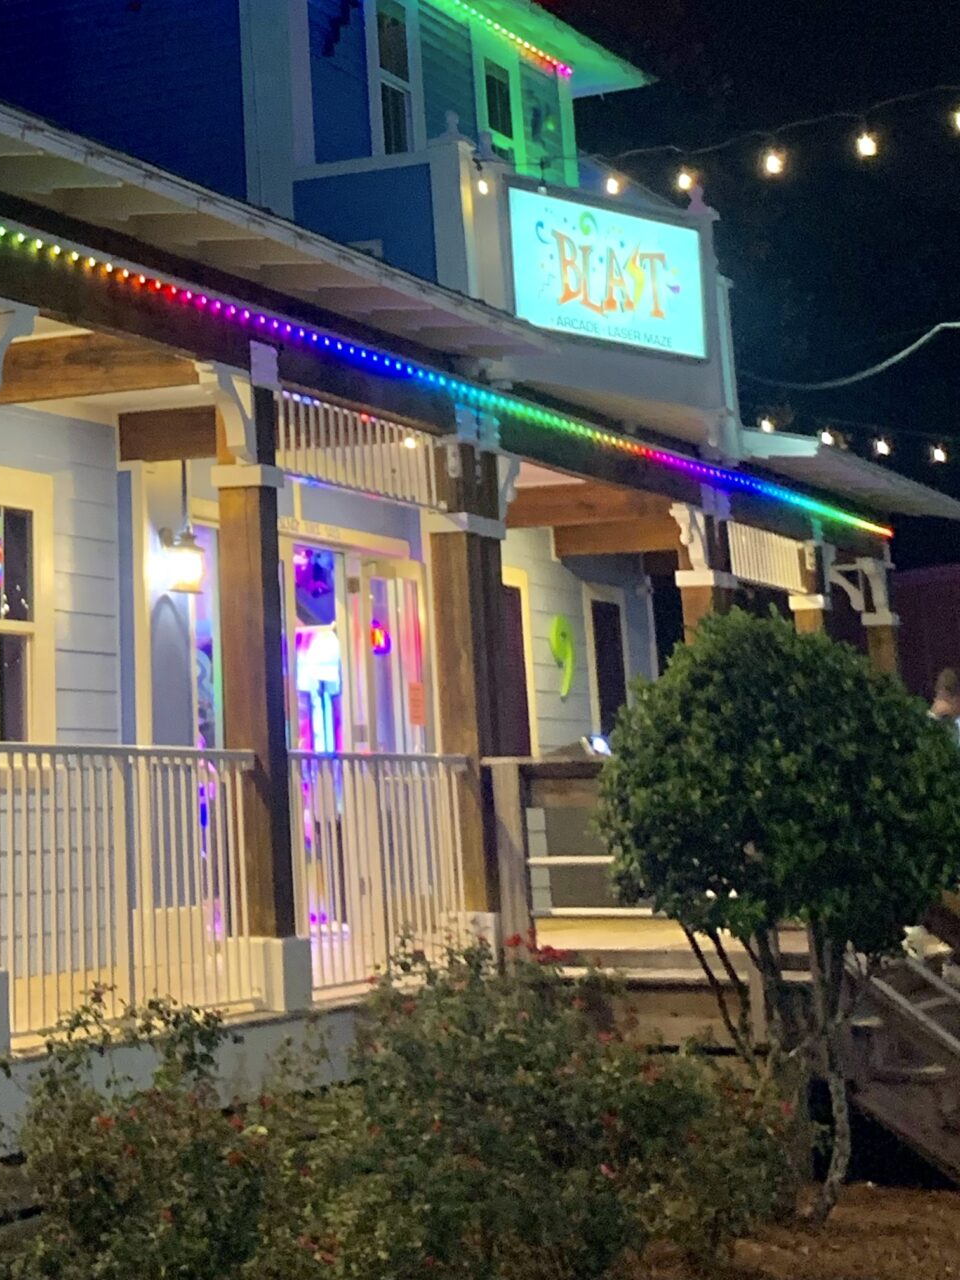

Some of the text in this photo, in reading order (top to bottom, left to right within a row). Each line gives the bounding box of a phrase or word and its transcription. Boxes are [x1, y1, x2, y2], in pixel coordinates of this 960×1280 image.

[551, 228, 668, 320] BLAST
[556, 315, 673, 347] ARCADE LASER MAZE
